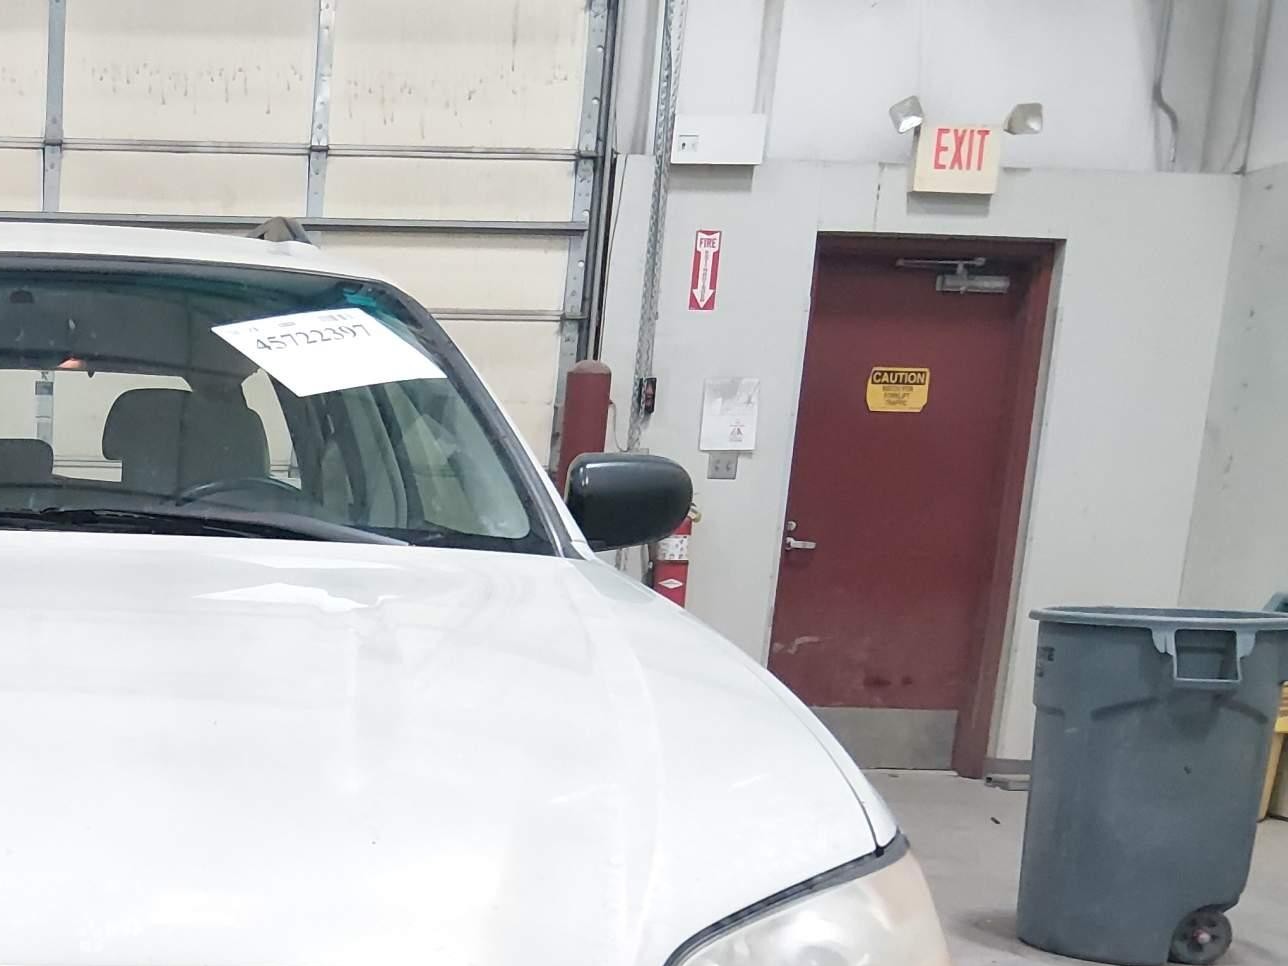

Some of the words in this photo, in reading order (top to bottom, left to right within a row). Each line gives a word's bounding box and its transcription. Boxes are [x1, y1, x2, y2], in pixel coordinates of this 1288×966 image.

[933, 128, 991, 171] EXIT
[699, 237, 717, 248] FIRE
[255, 323, 372, 351] 45722397
[872, 371, 925, 384] CAUTION
